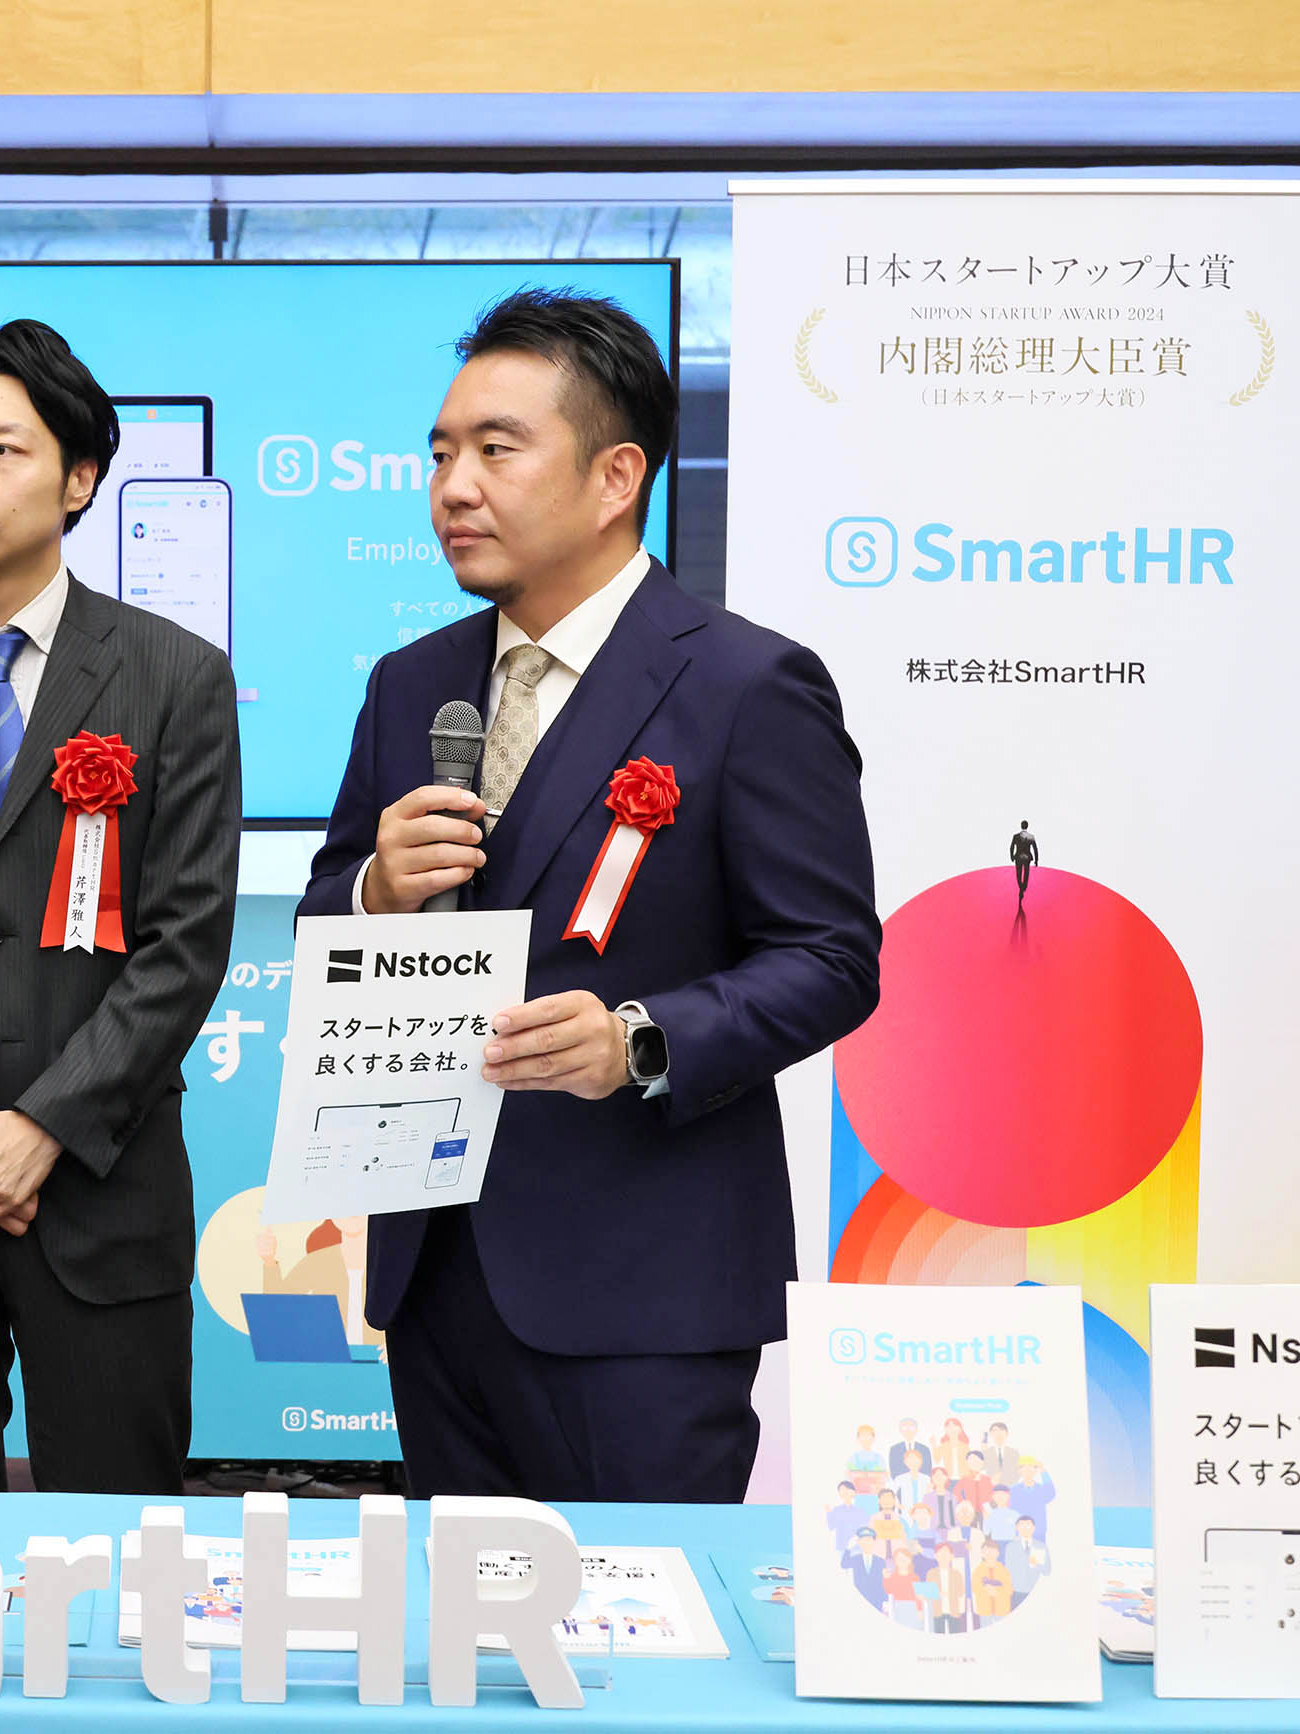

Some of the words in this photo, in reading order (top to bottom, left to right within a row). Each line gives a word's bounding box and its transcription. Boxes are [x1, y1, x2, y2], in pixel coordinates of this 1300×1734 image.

[845, 252, 1235, 291] 日本スタートアップ大賞
[909, 306, 973, 322] NIPPON
[980, 306, 1053, 322] STARTUP
[1059, 306, 1121, 322] AWARD
[1127, 306, 1166, 322] 2024
[878, 335, 1193, 377] 内閣総理大臣賞
[911, 522, 1235, 586] SmartHR
[905, 657, 1147, 686] 株式会社SmartHR
[70, 875, 87, 939] 芹澤雅人
[374, 950, 493, 978] Nstock
[314, 1051, 469, 1076] 良くする会社。
[873, 1331, 1042, 1365] SmartHR
[1195, 1413, 1300, 1439] スタート
